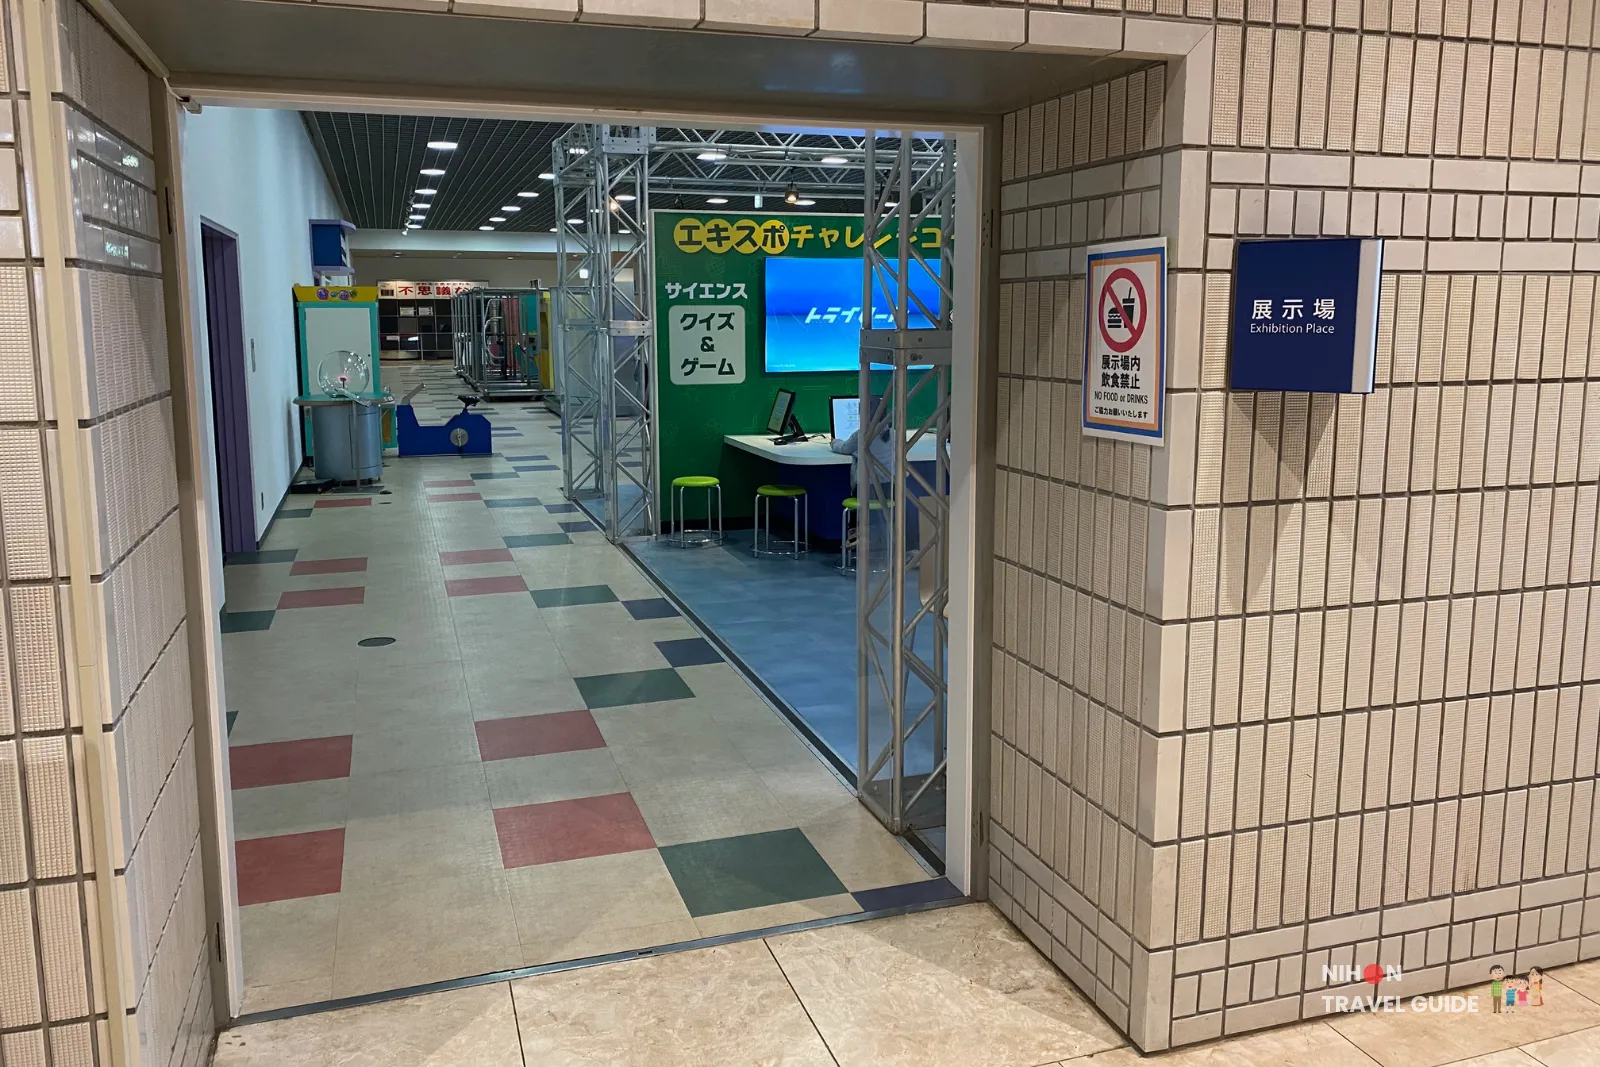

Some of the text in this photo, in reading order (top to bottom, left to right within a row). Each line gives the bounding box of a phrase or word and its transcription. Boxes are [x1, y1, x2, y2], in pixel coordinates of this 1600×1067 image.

[665, 283, 748, 299] サイエンス
[1252, 298, 1336, 320] 展示場
[680, 312, 735, 331] クイズ
[1250, 323, 1335, 334] Exhibition Place
[700, 336, 715, 352] &
[680, 357, 735, 376] ゲーム
[1101, 354, 1141, 371] 展示場内
[1101, 371, 1140, 390] 飲食禁止
[1094, 390, 1148, 405] NO FOOD or DRINKS
[1094, 406, 1148, 419] ご協力お願いいたします
